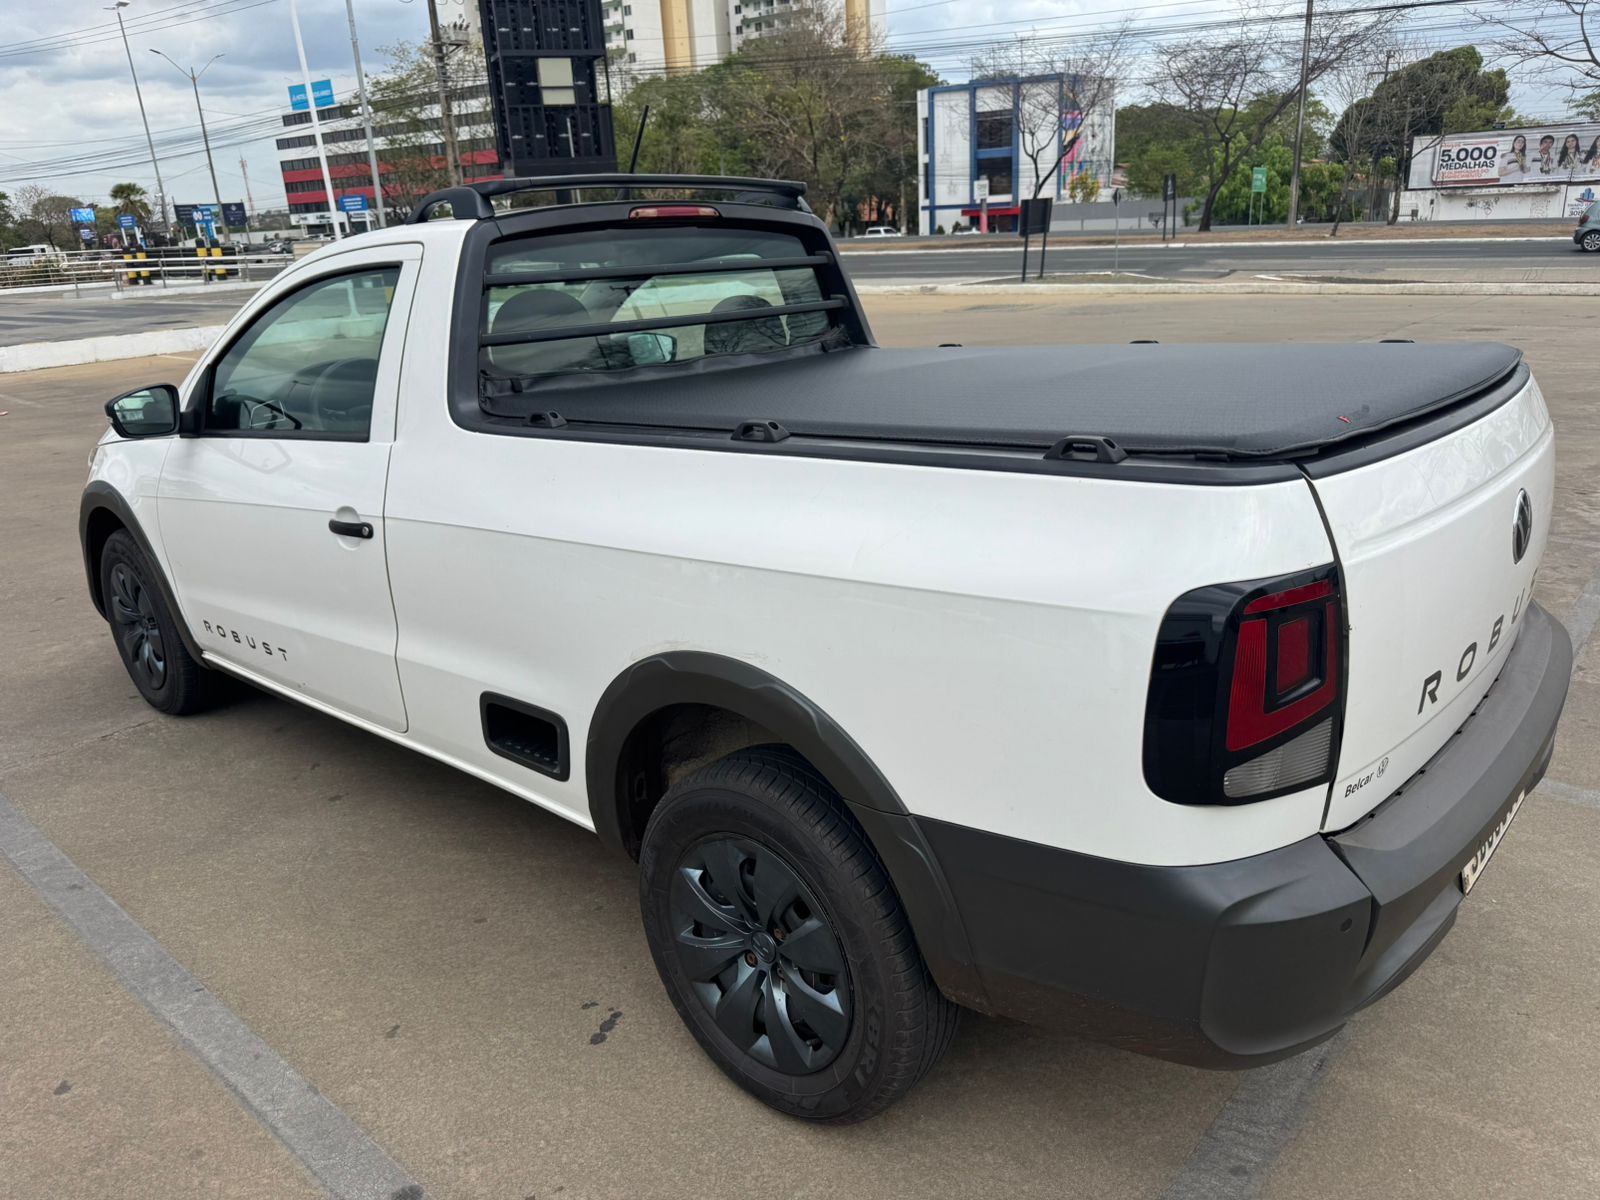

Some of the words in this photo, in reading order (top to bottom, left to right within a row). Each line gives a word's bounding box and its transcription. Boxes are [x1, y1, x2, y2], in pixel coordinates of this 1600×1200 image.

[1440, 146, 1497, 162] 5.000
[1439, 160, 1495, 171] MEDALHAS
[203, 619, 287, 662] ROBUST
[1344, 771, 1375, 798] Belcar
